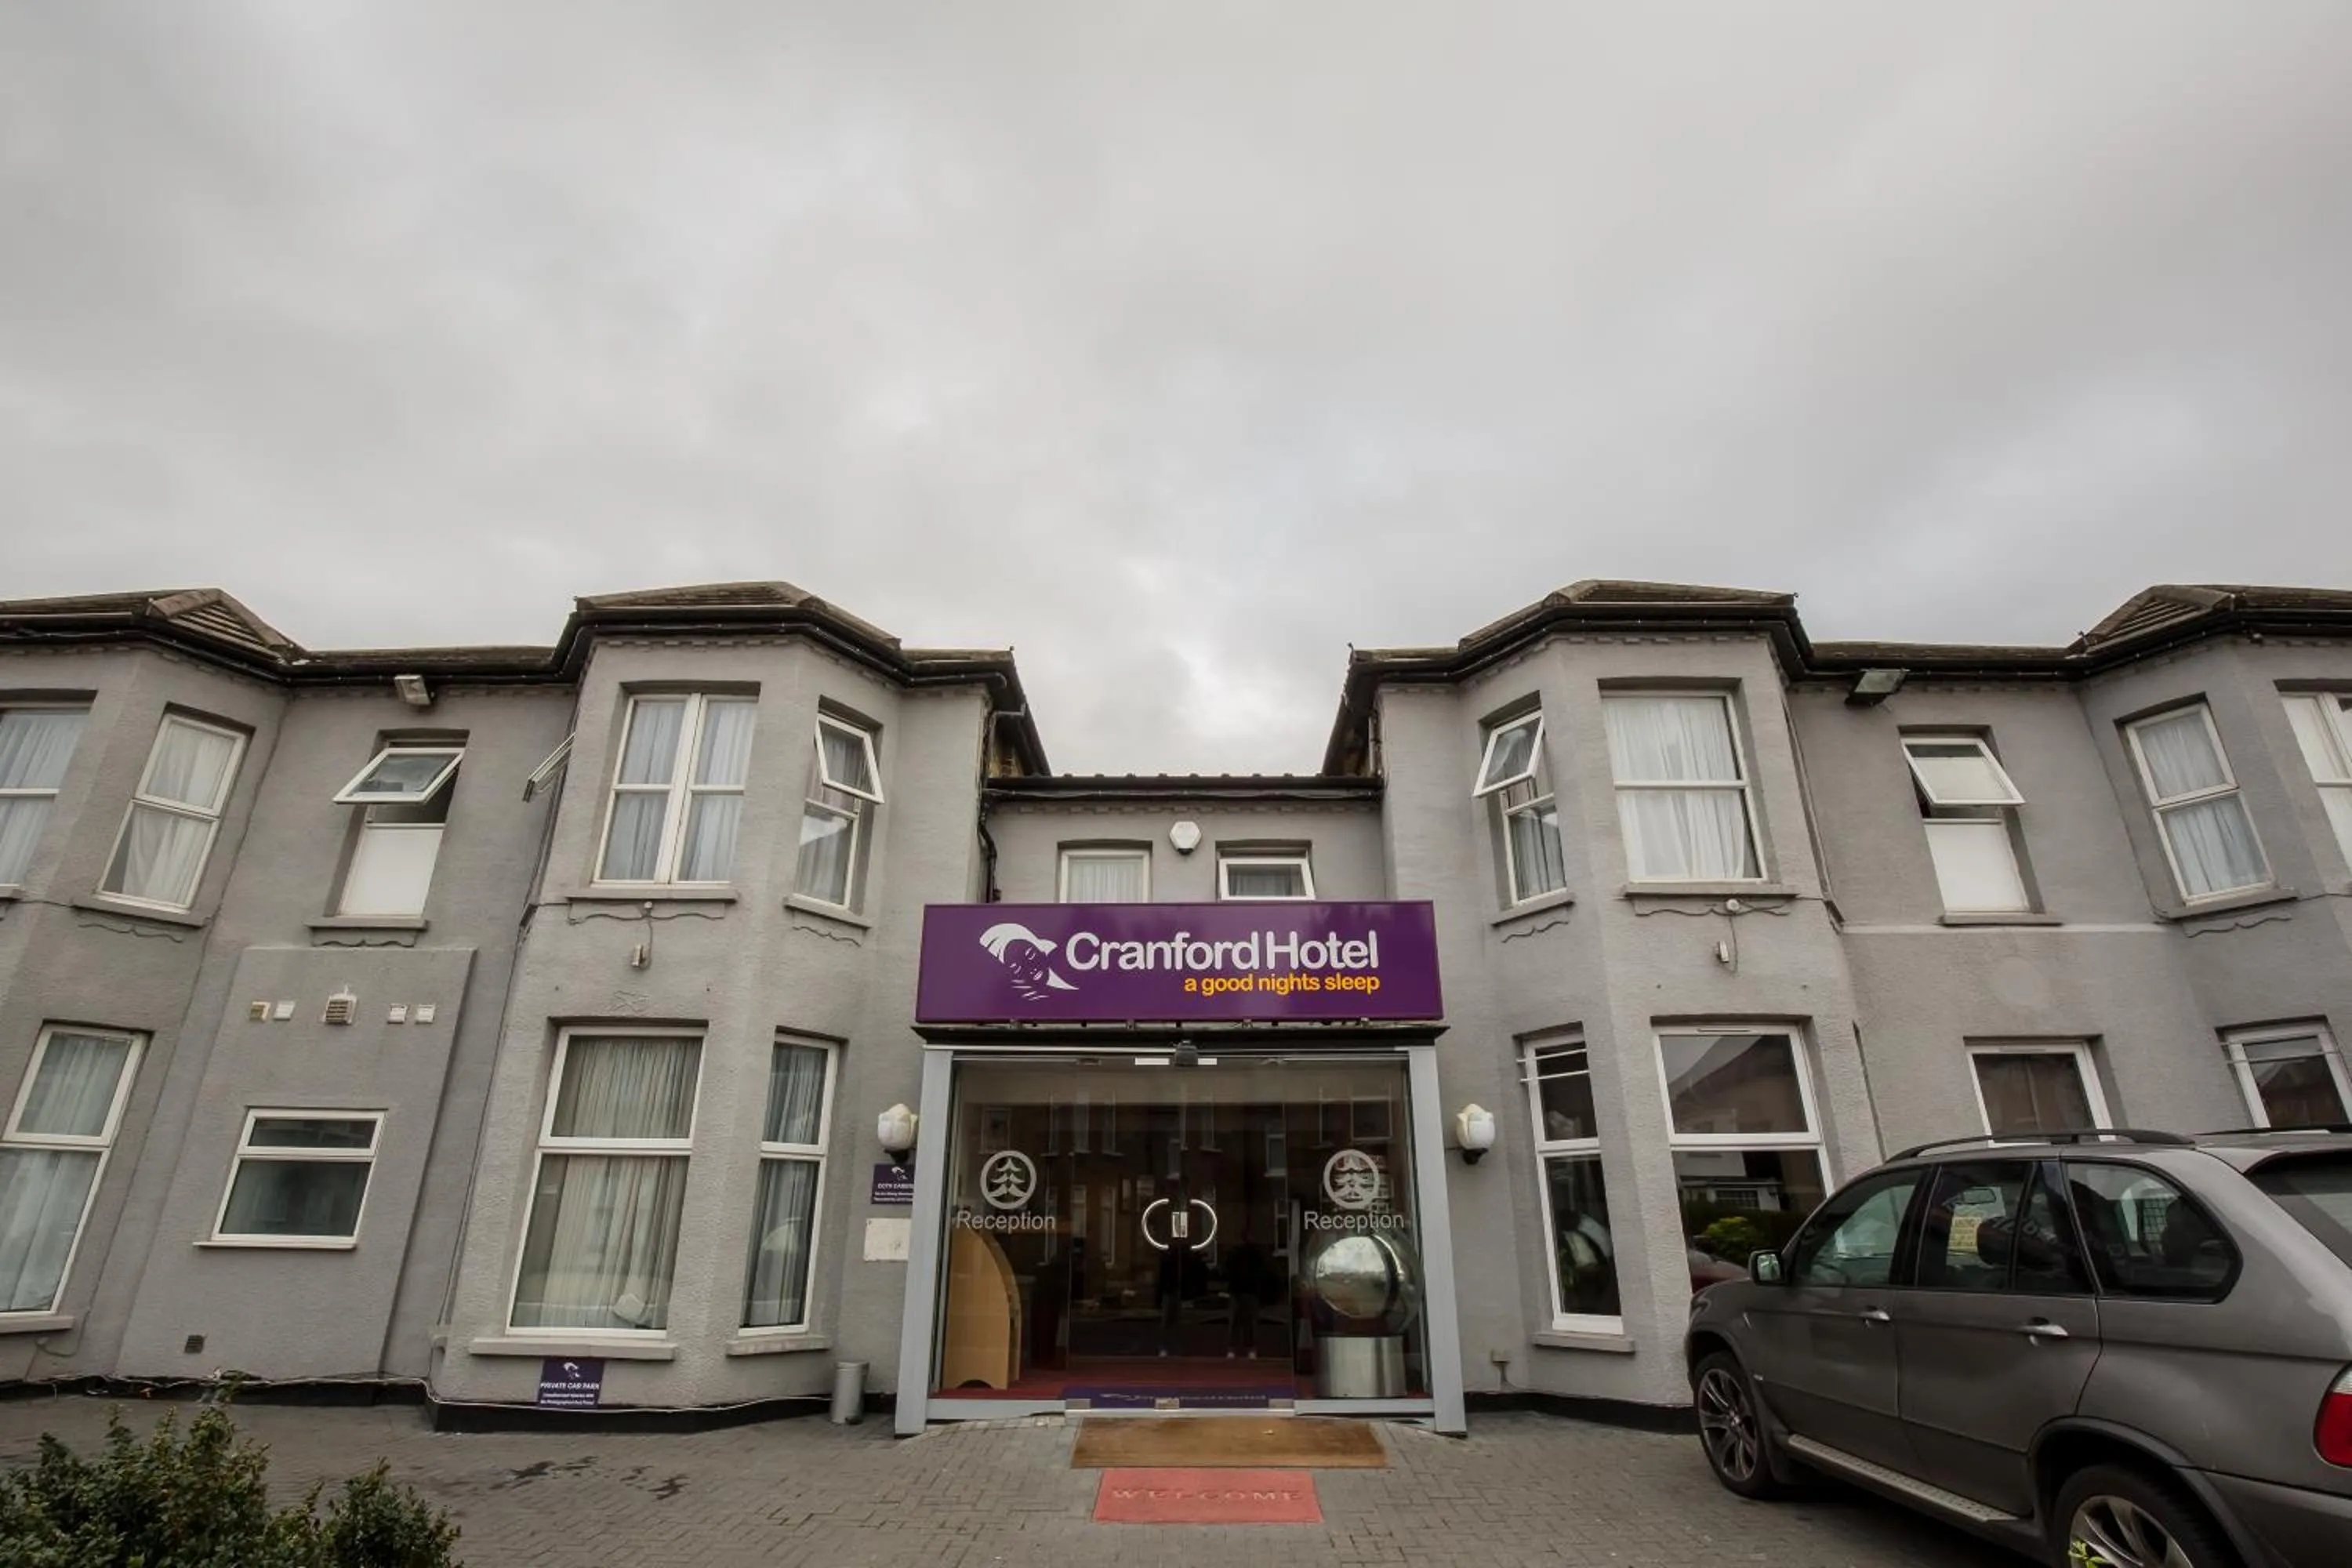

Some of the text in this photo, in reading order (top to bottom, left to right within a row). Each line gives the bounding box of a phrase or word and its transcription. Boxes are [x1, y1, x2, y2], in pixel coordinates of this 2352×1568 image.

[1065, 930, 1379, 971] Cranford Hotel
[1183, 973, 1381, 997] a good nights sleep
[956, 1210, 1056, 1235] Reception
[1303, 1210, 1405, 1234] Reception
[1112, 1489, 1303, 1501] WELCOME
